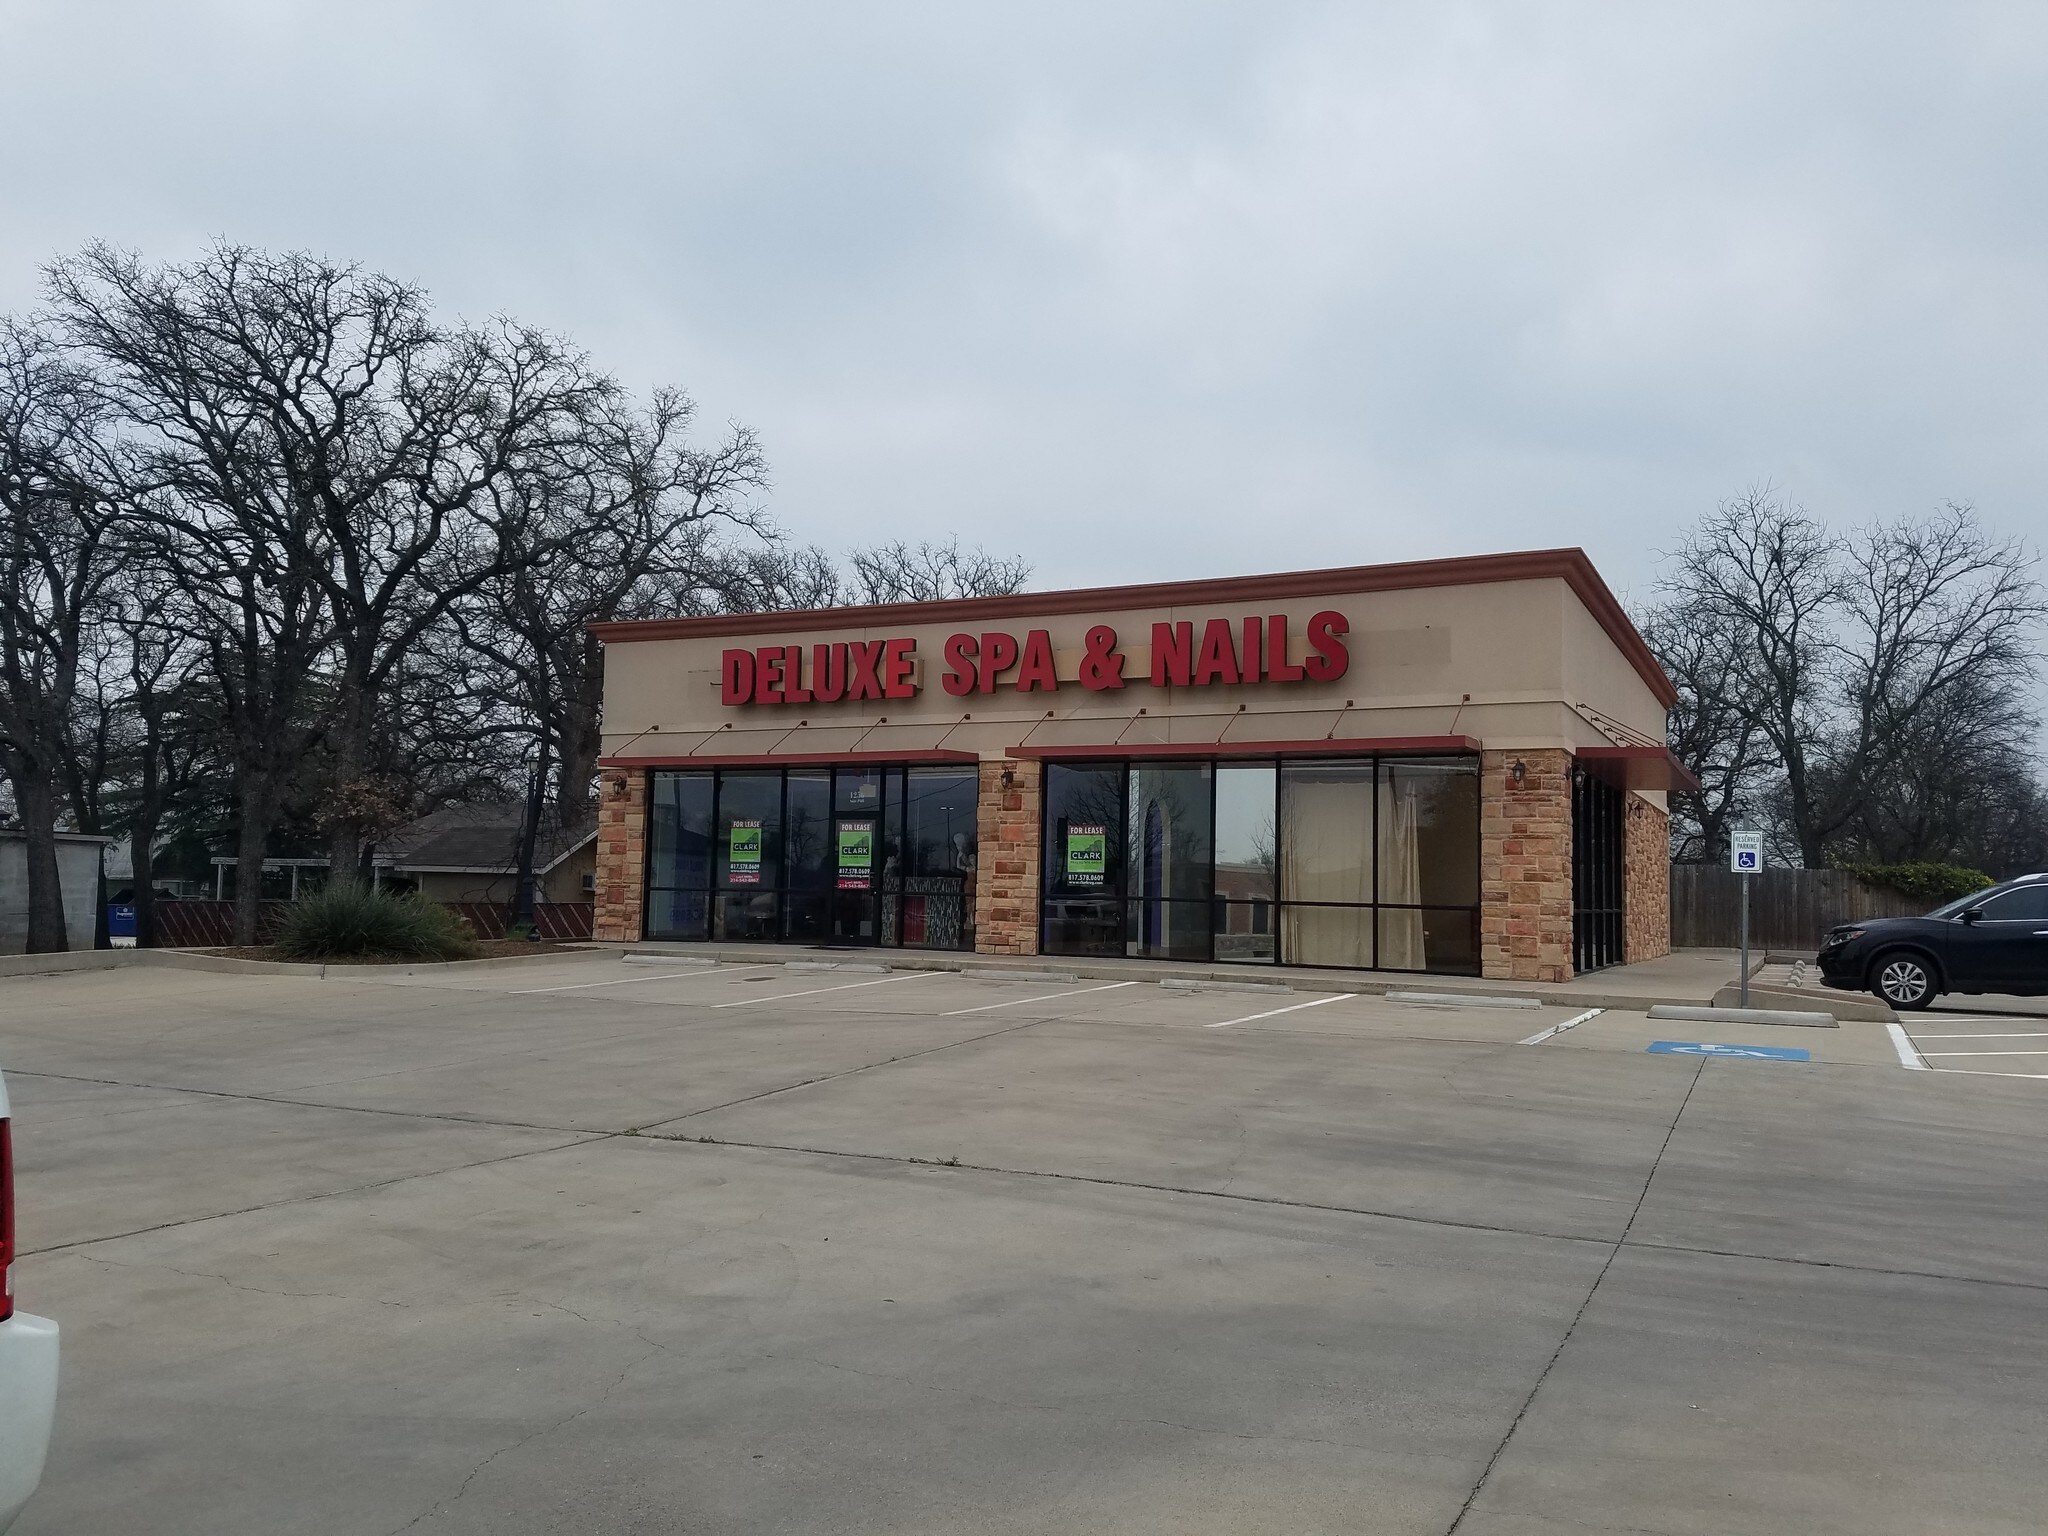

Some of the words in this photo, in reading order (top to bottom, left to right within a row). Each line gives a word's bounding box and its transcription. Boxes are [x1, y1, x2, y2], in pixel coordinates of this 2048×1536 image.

[721, 638, 918, 706] DELUXE
[941, 629, 1059, 697] SPA
[1078, 624, 1126, 691] &
[1150, 610, 1350, 688] NAILS
[733, 820, 744, 828] FOR
[744, 820, 760, 828] LEASE
[841, 823, 853, 831] FOR
[853, 823, 870, 831] LEASE
[1070, 826, 1083, 834] FOR
[1084, 826, 1103, 834] LEASE
[734, 843, 758, 851] CLARK
